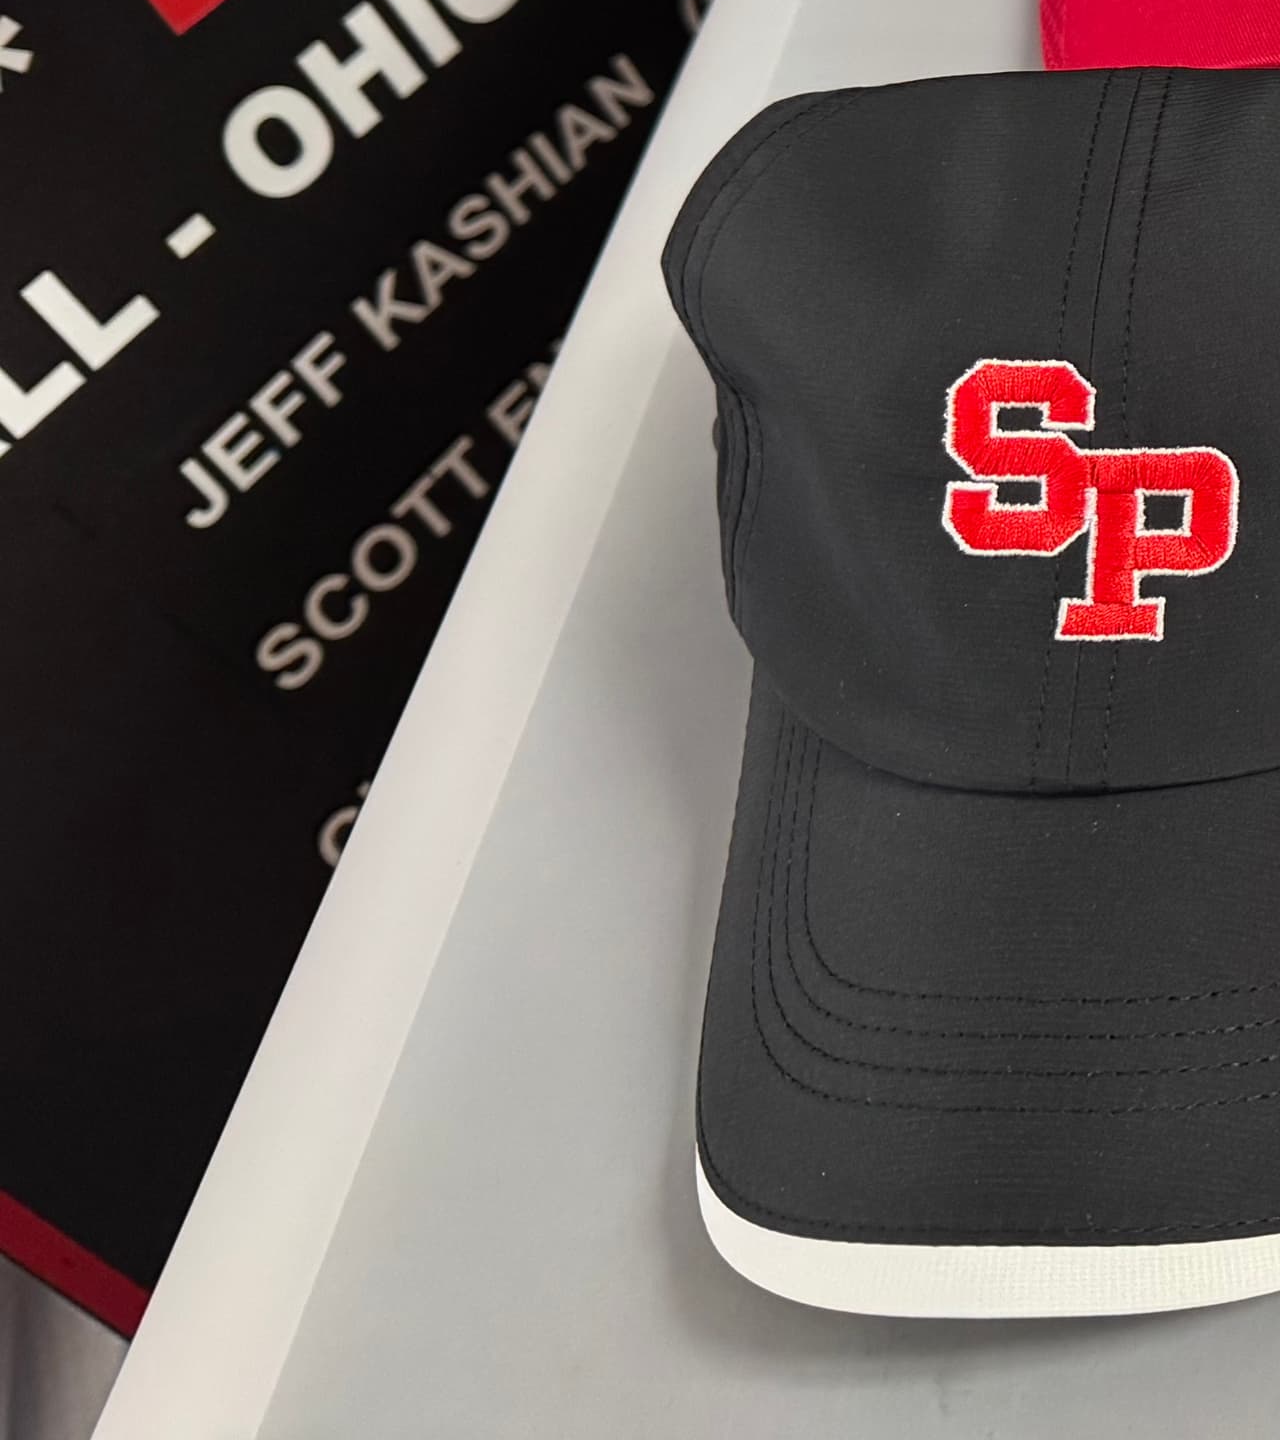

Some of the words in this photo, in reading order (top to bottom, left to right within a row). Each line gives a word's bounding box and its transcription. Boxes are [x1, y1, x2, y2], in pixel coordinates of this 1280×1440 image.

[178, 330, 346, 529] JEFF
[350, 53, 656, 352] KASHIAN
[256, 434, 490, 691] SCOTT
[942, 358, 1239, 642] SP
